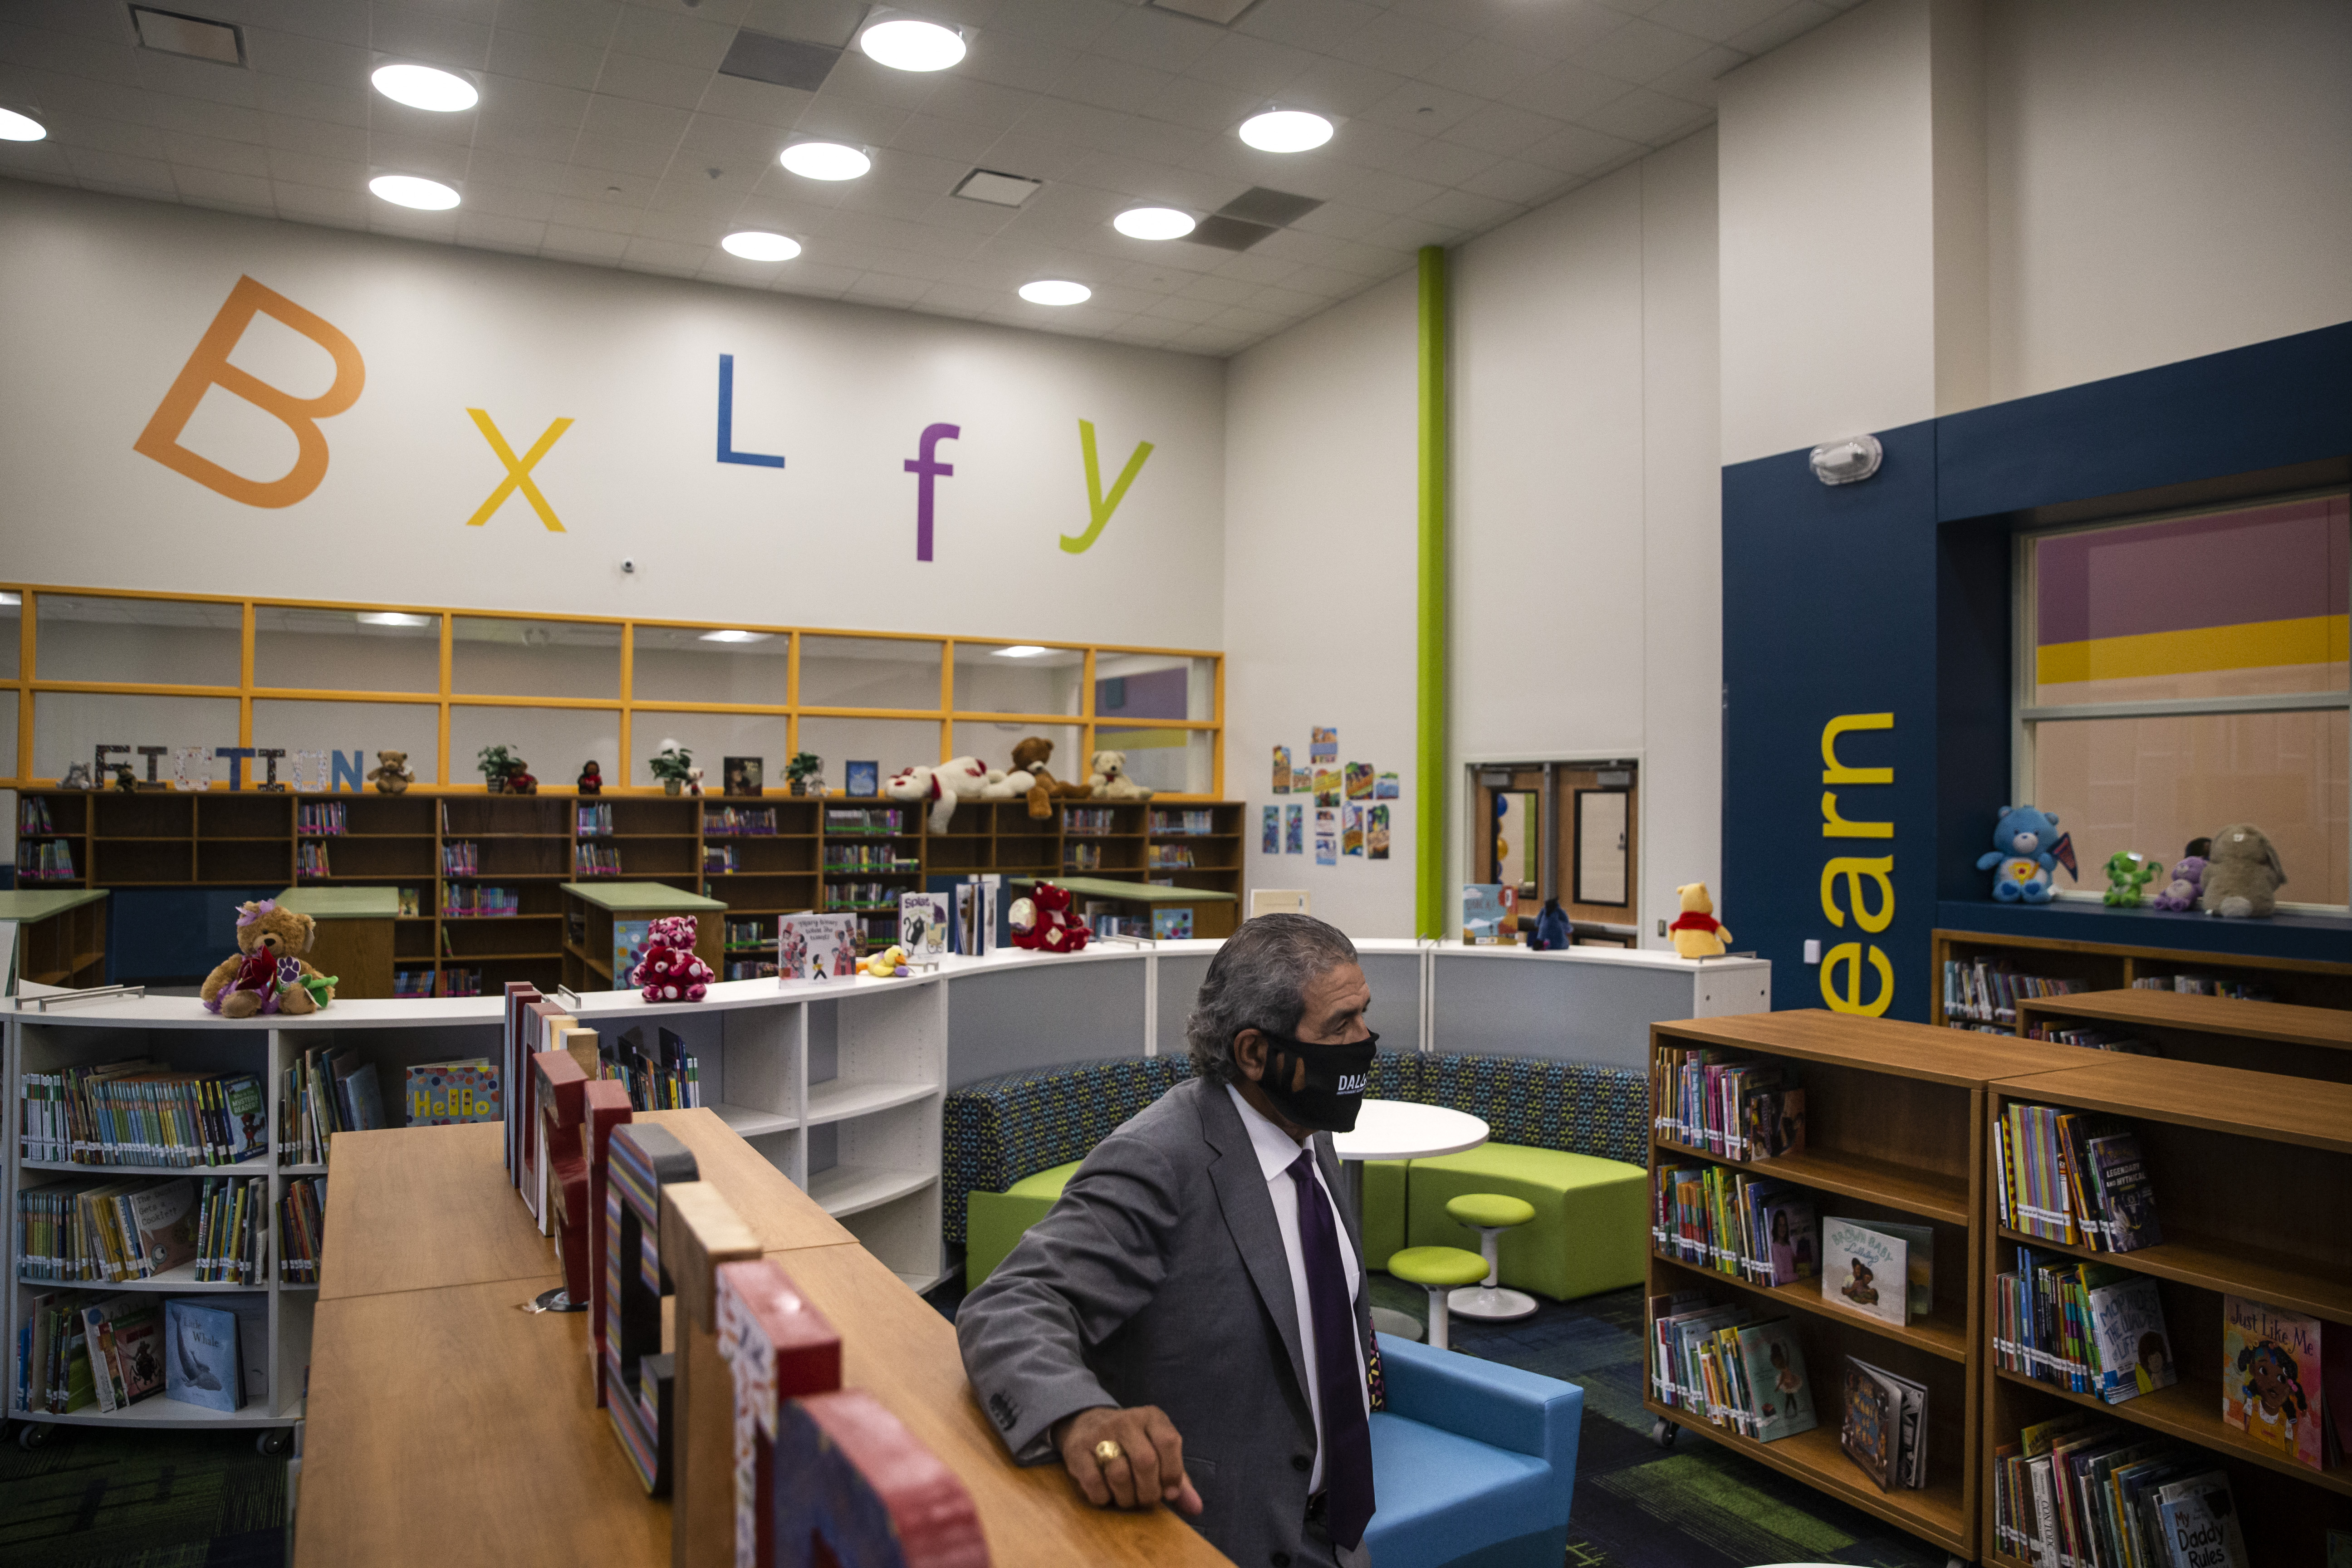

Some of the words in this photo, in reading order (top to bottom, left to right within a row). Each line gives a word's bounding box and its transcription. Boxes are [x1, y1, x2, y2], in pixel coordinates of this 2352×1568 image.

[134, 275, 364, 508] B
[718, 355, 784, 466] L
[904, 424, 958, 561] f
[95, 745, 363, 793] FICTION
[414, 1088, 490, 1117] Hello
[192, 1331, 219, 1348] Whale
[2230, 1303, 2258, 1333] Just
[2262, 1313, 2288, 1345] Like
[2288, 1327, 2313, 1356] Me
[2041, 1500, 2051, 1520] CON
[2175, 1511, 2189, 1528] My
[2177, 1521, 2223, 1552] Daddy
[2188, 1547, 2225, 1568] Rules
